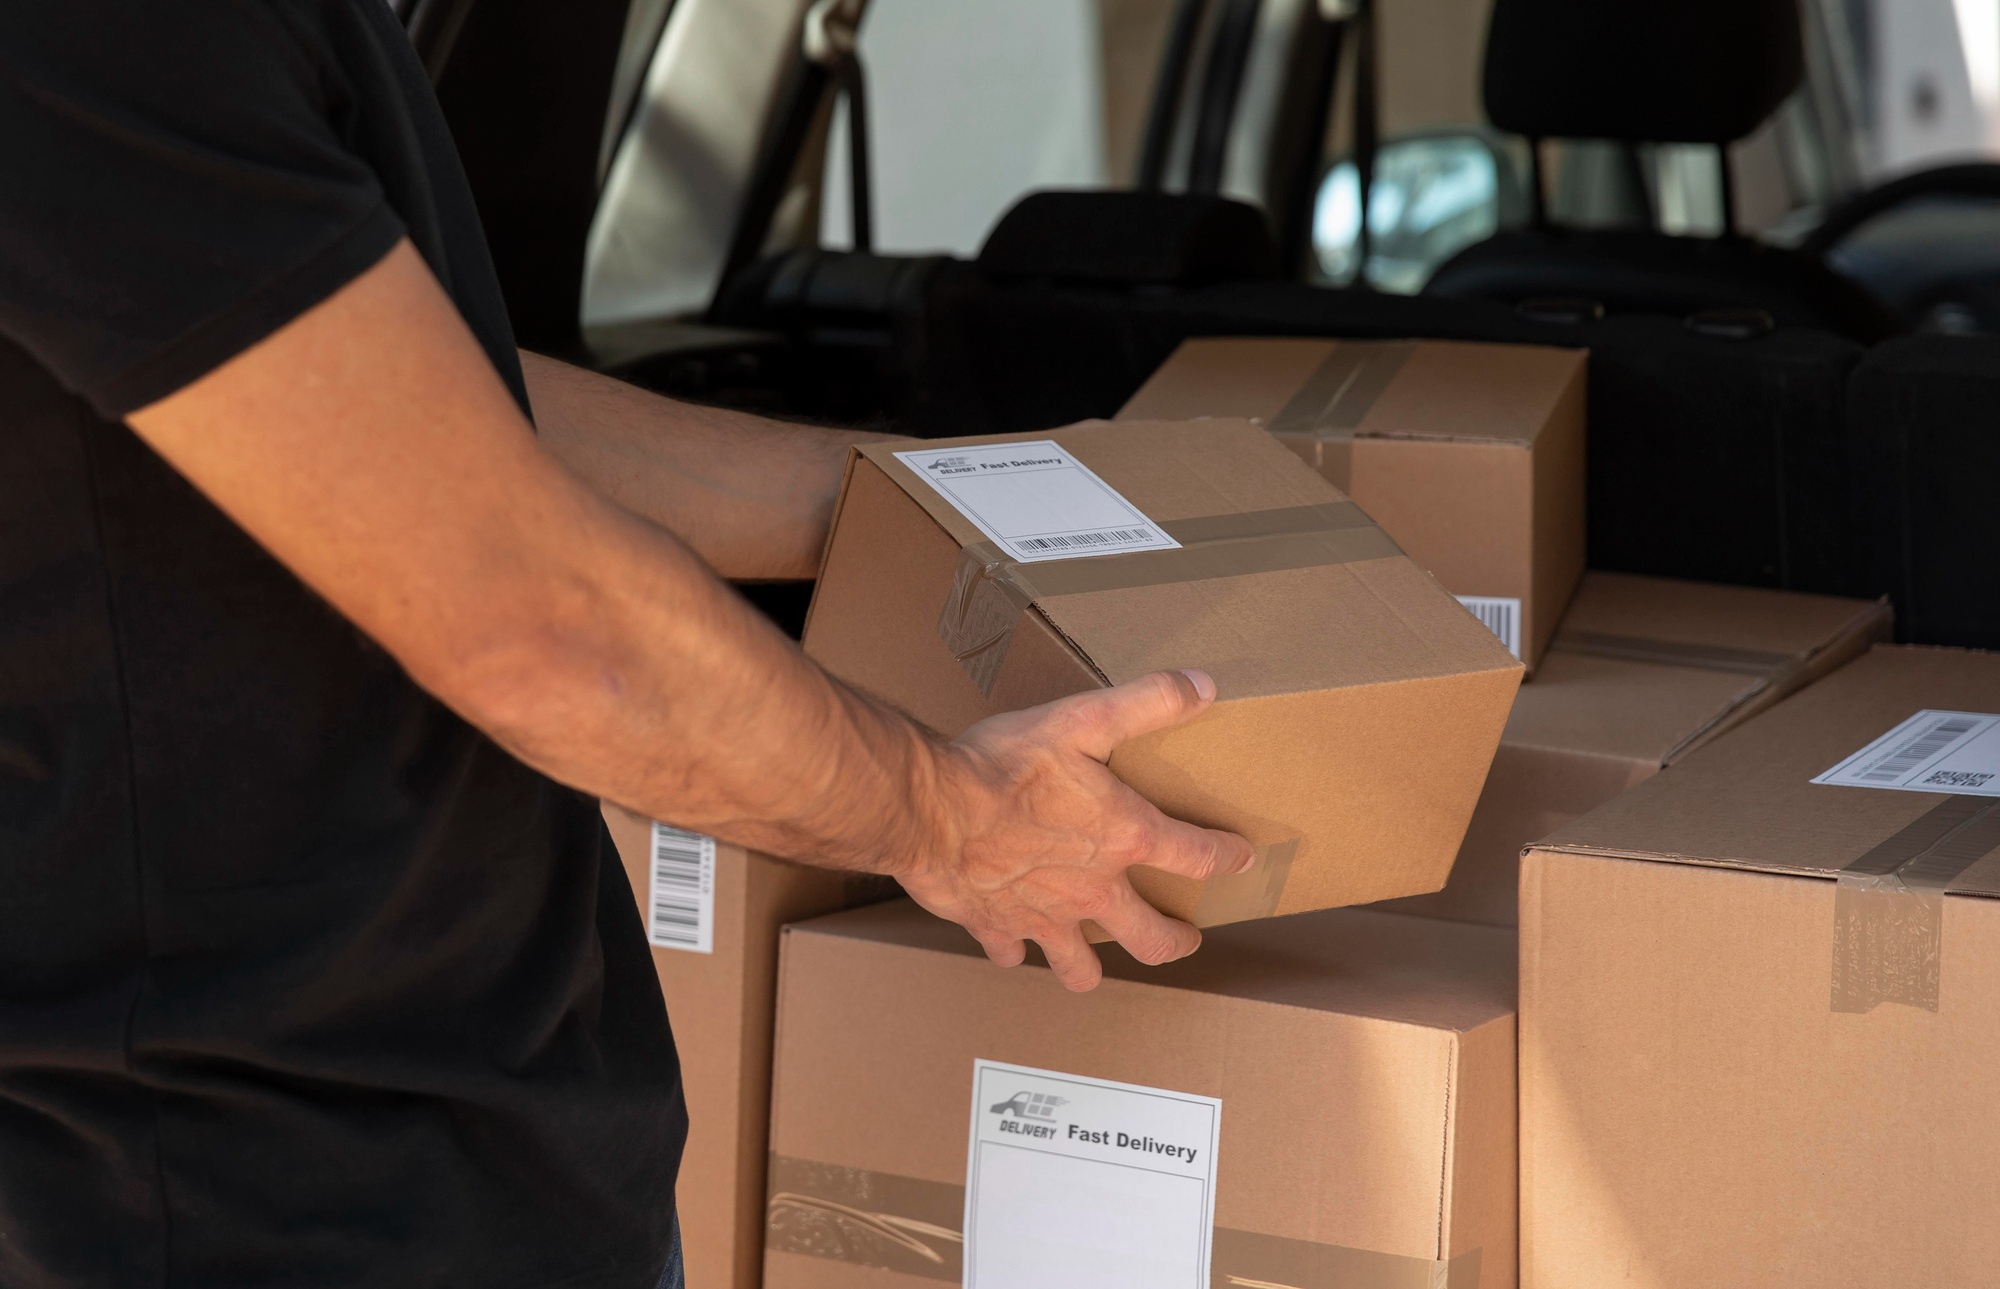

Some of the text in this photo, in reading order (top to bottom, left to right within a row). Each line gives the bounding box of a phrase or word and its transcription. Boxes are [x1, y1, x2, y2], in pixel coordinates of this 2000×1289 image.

[940, 466, 977, 475] DELIVERY
[980, 457, 1062, 470] Fast Delivery
[999, 1119, 1057, 1140] DELIVERY
[1067, 1123, 1198, 1164] Fast Delivery
